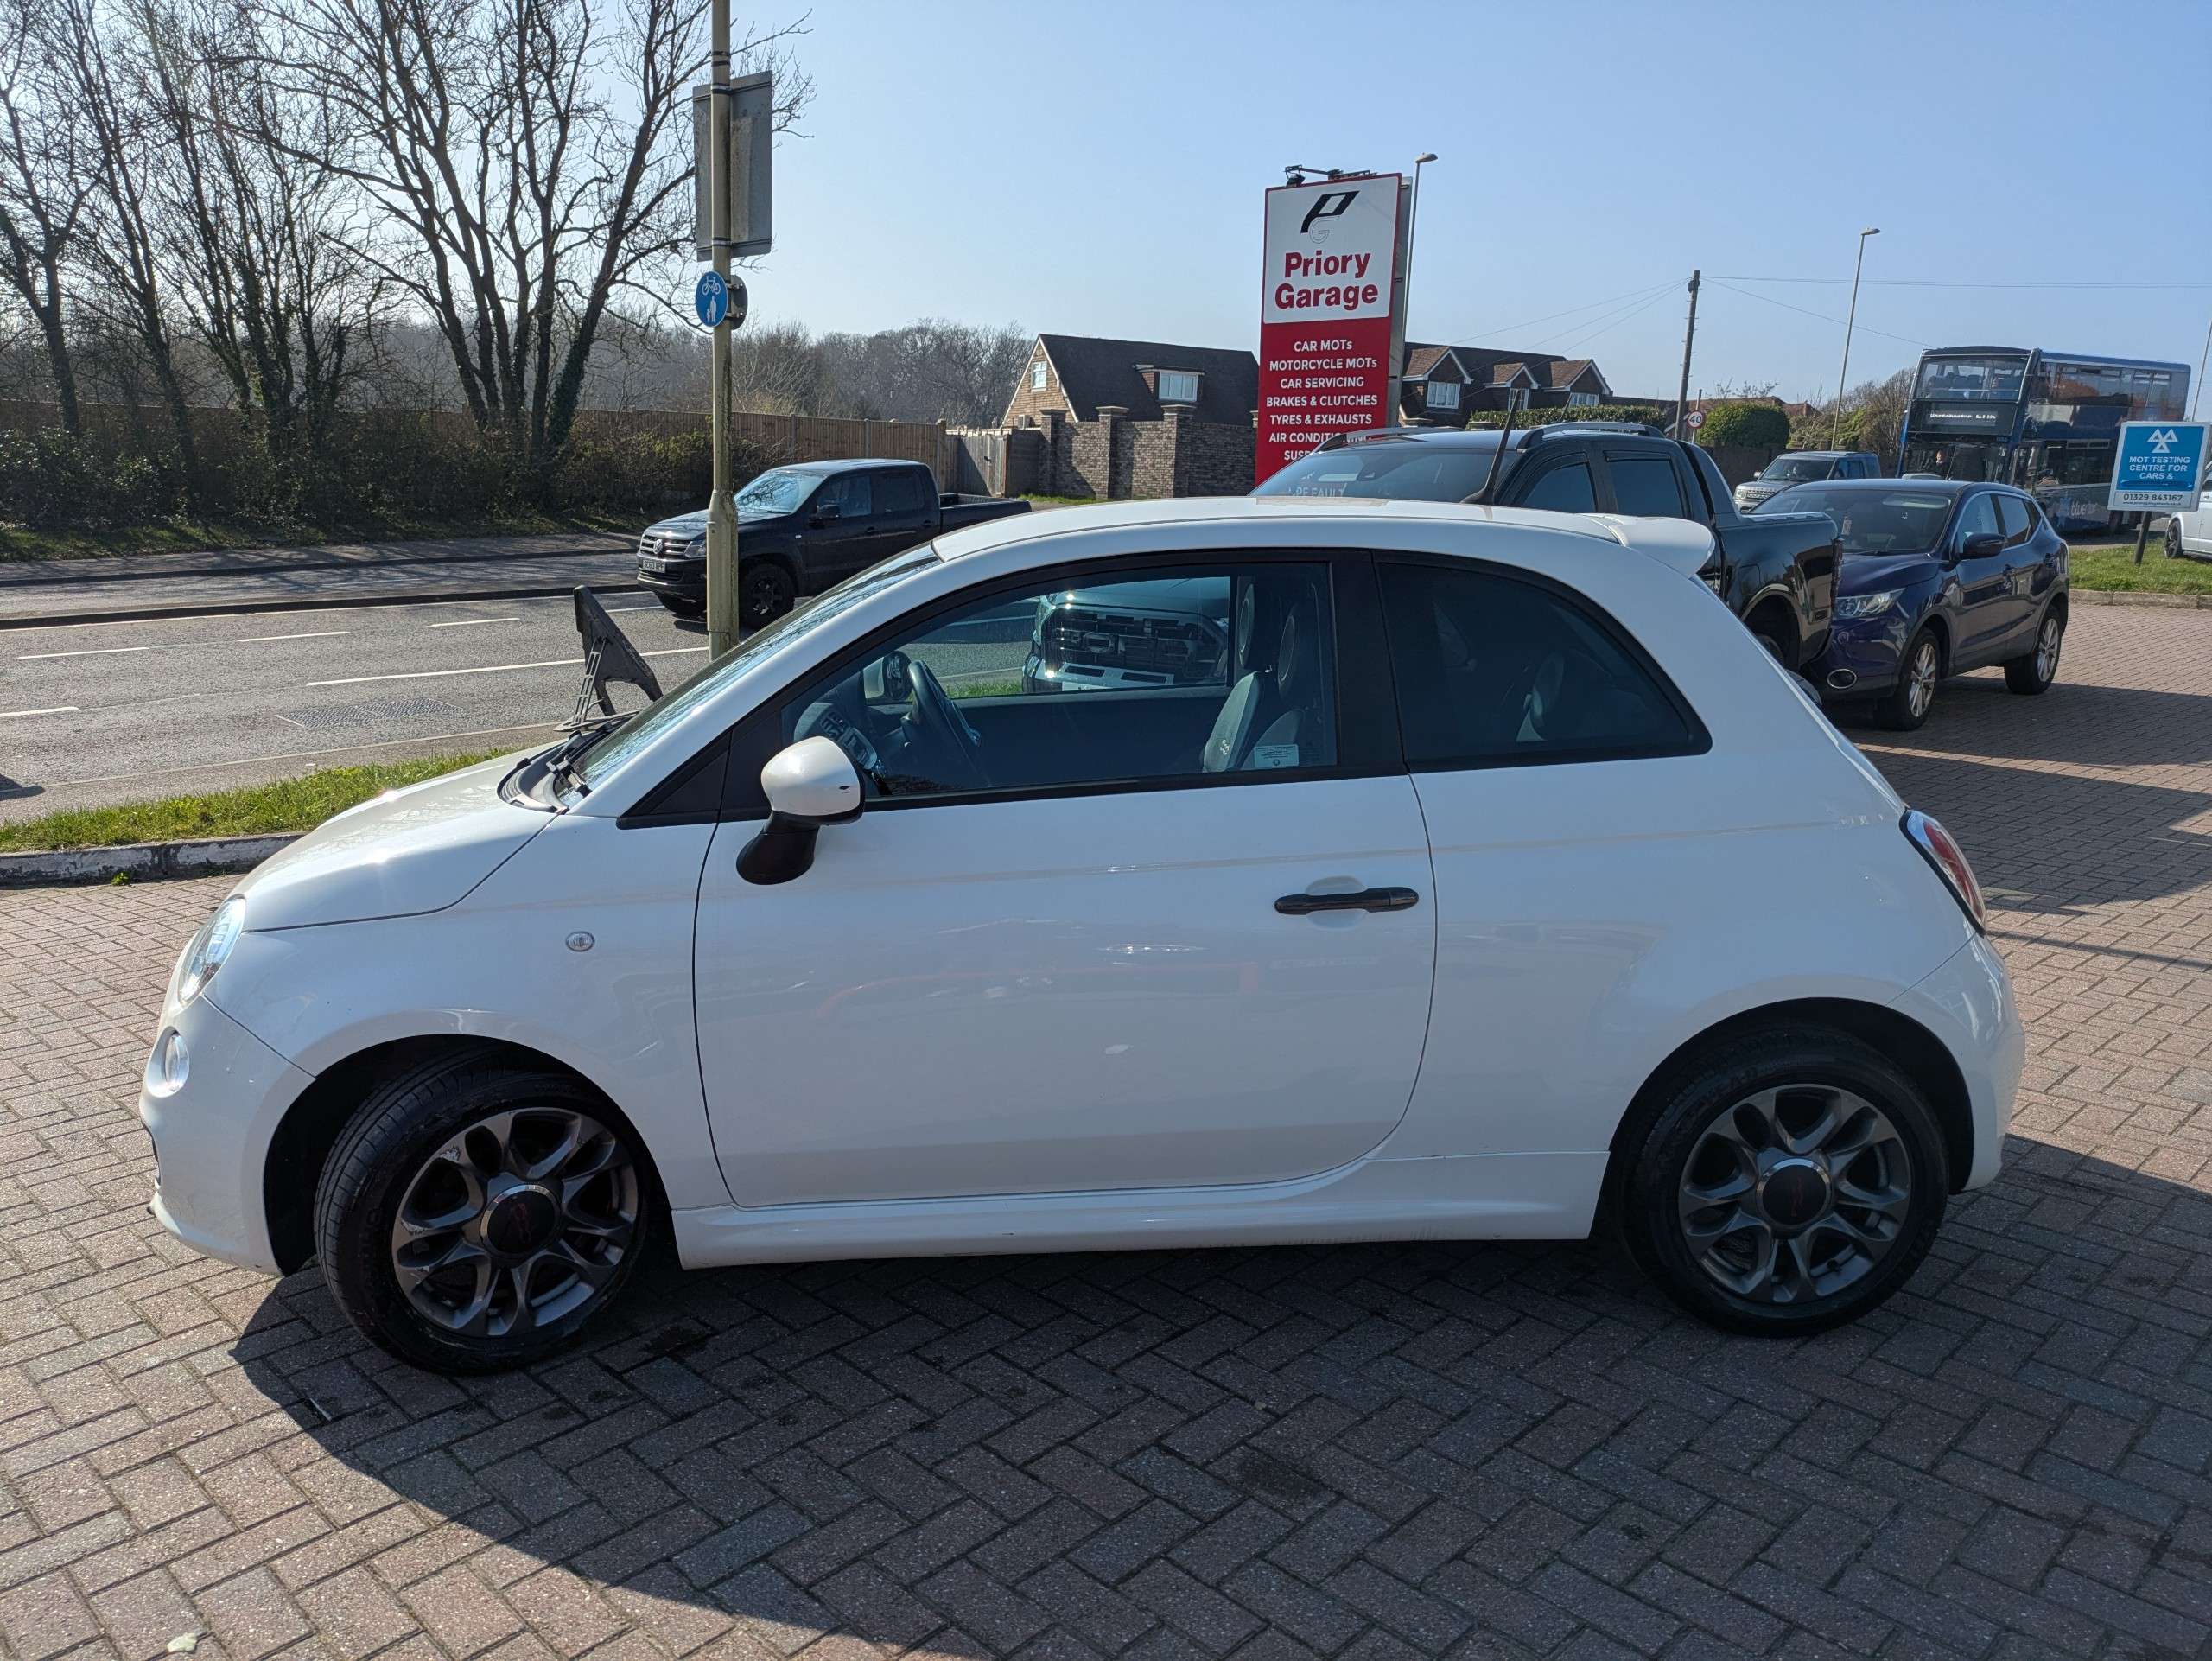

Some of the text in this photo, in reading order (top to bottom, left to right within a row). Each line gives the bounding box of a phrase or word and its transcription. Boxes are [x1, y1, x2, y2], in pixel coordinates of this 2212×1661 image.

[1284, 250, 1371, 279] Priory
[1274, 283, 1378, 311] Garage
[1294, 339, 1352, 353] CAR MOTs
[1269, 358, 1377, 371] MOTORCYCLE MOTs
[1280, 376, 1363, 388] CAR SERVICING
[1267, 394, 1377, 408] BRAKES & CLUTCHES
[1270, 413, 1372, 425] TYRES & EXHAUSTS
[1689, 415, 1701, 424] 40
[1268, 432, 1287, 443] AIR
